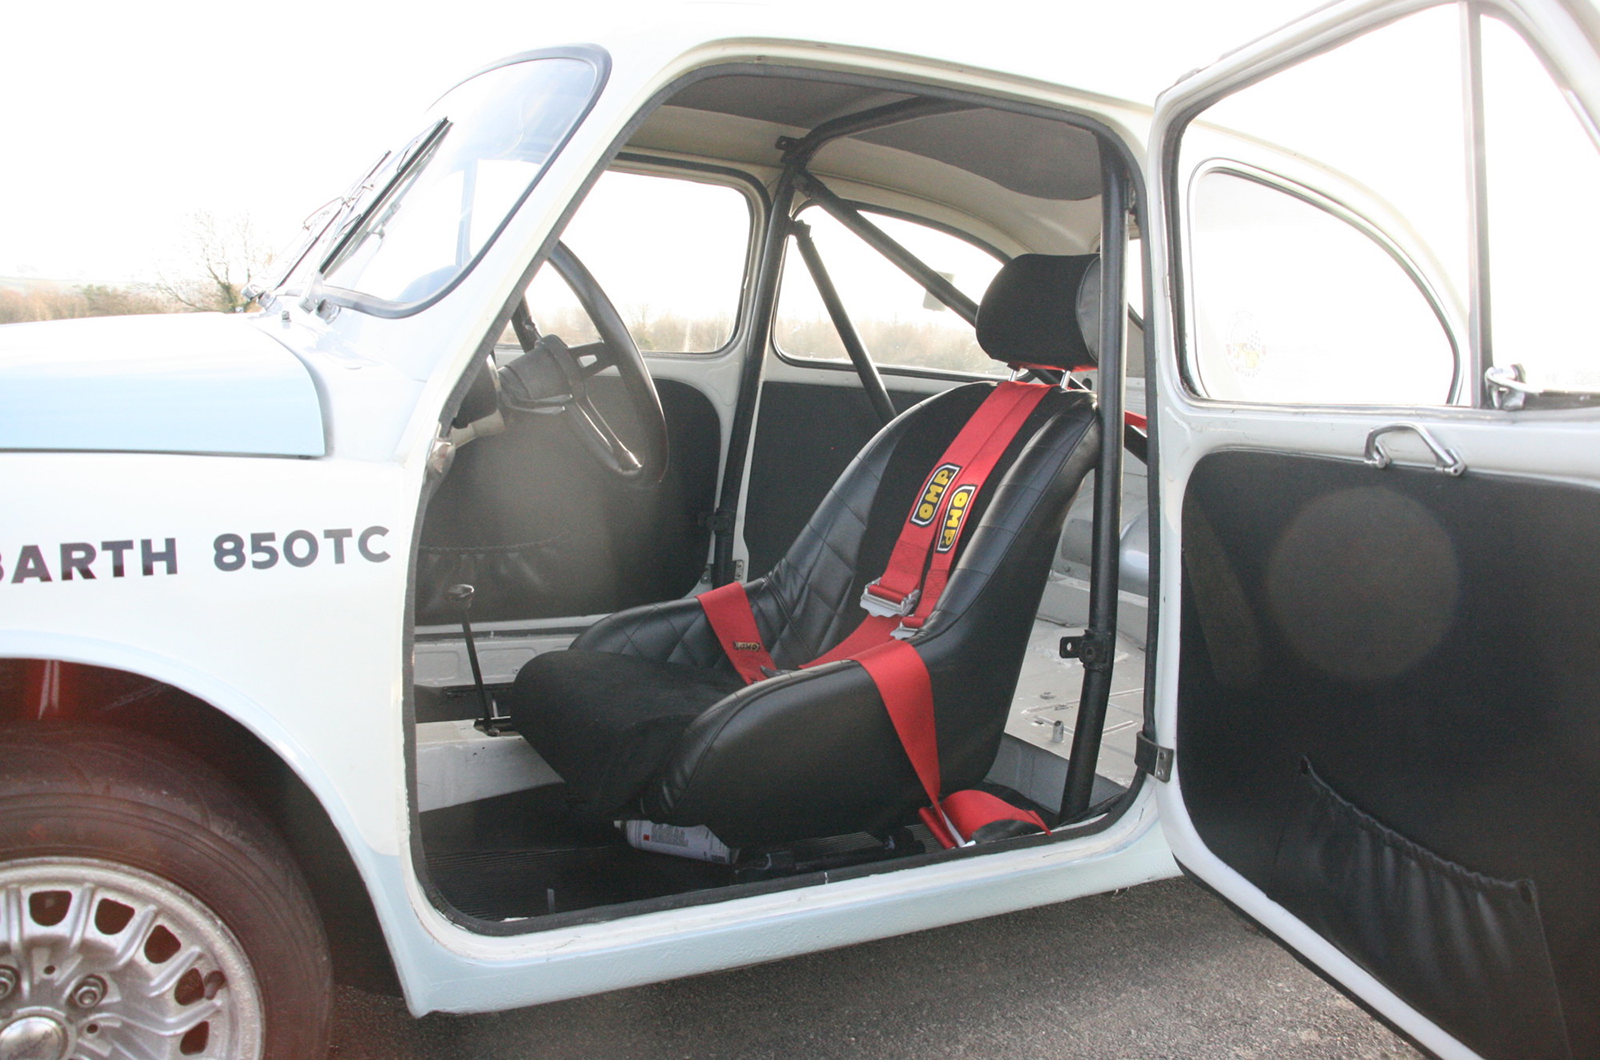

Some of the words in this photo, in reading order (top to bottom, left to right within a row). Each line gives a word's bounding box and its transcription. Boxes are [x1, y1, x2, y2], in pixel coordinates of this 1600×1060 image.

[919, 470, 949, 520] OMP
[944, 492, 968, 546] OMP
[0, 537, 178, 584] ARTH
[213, 525, 391, 572] 850TC
